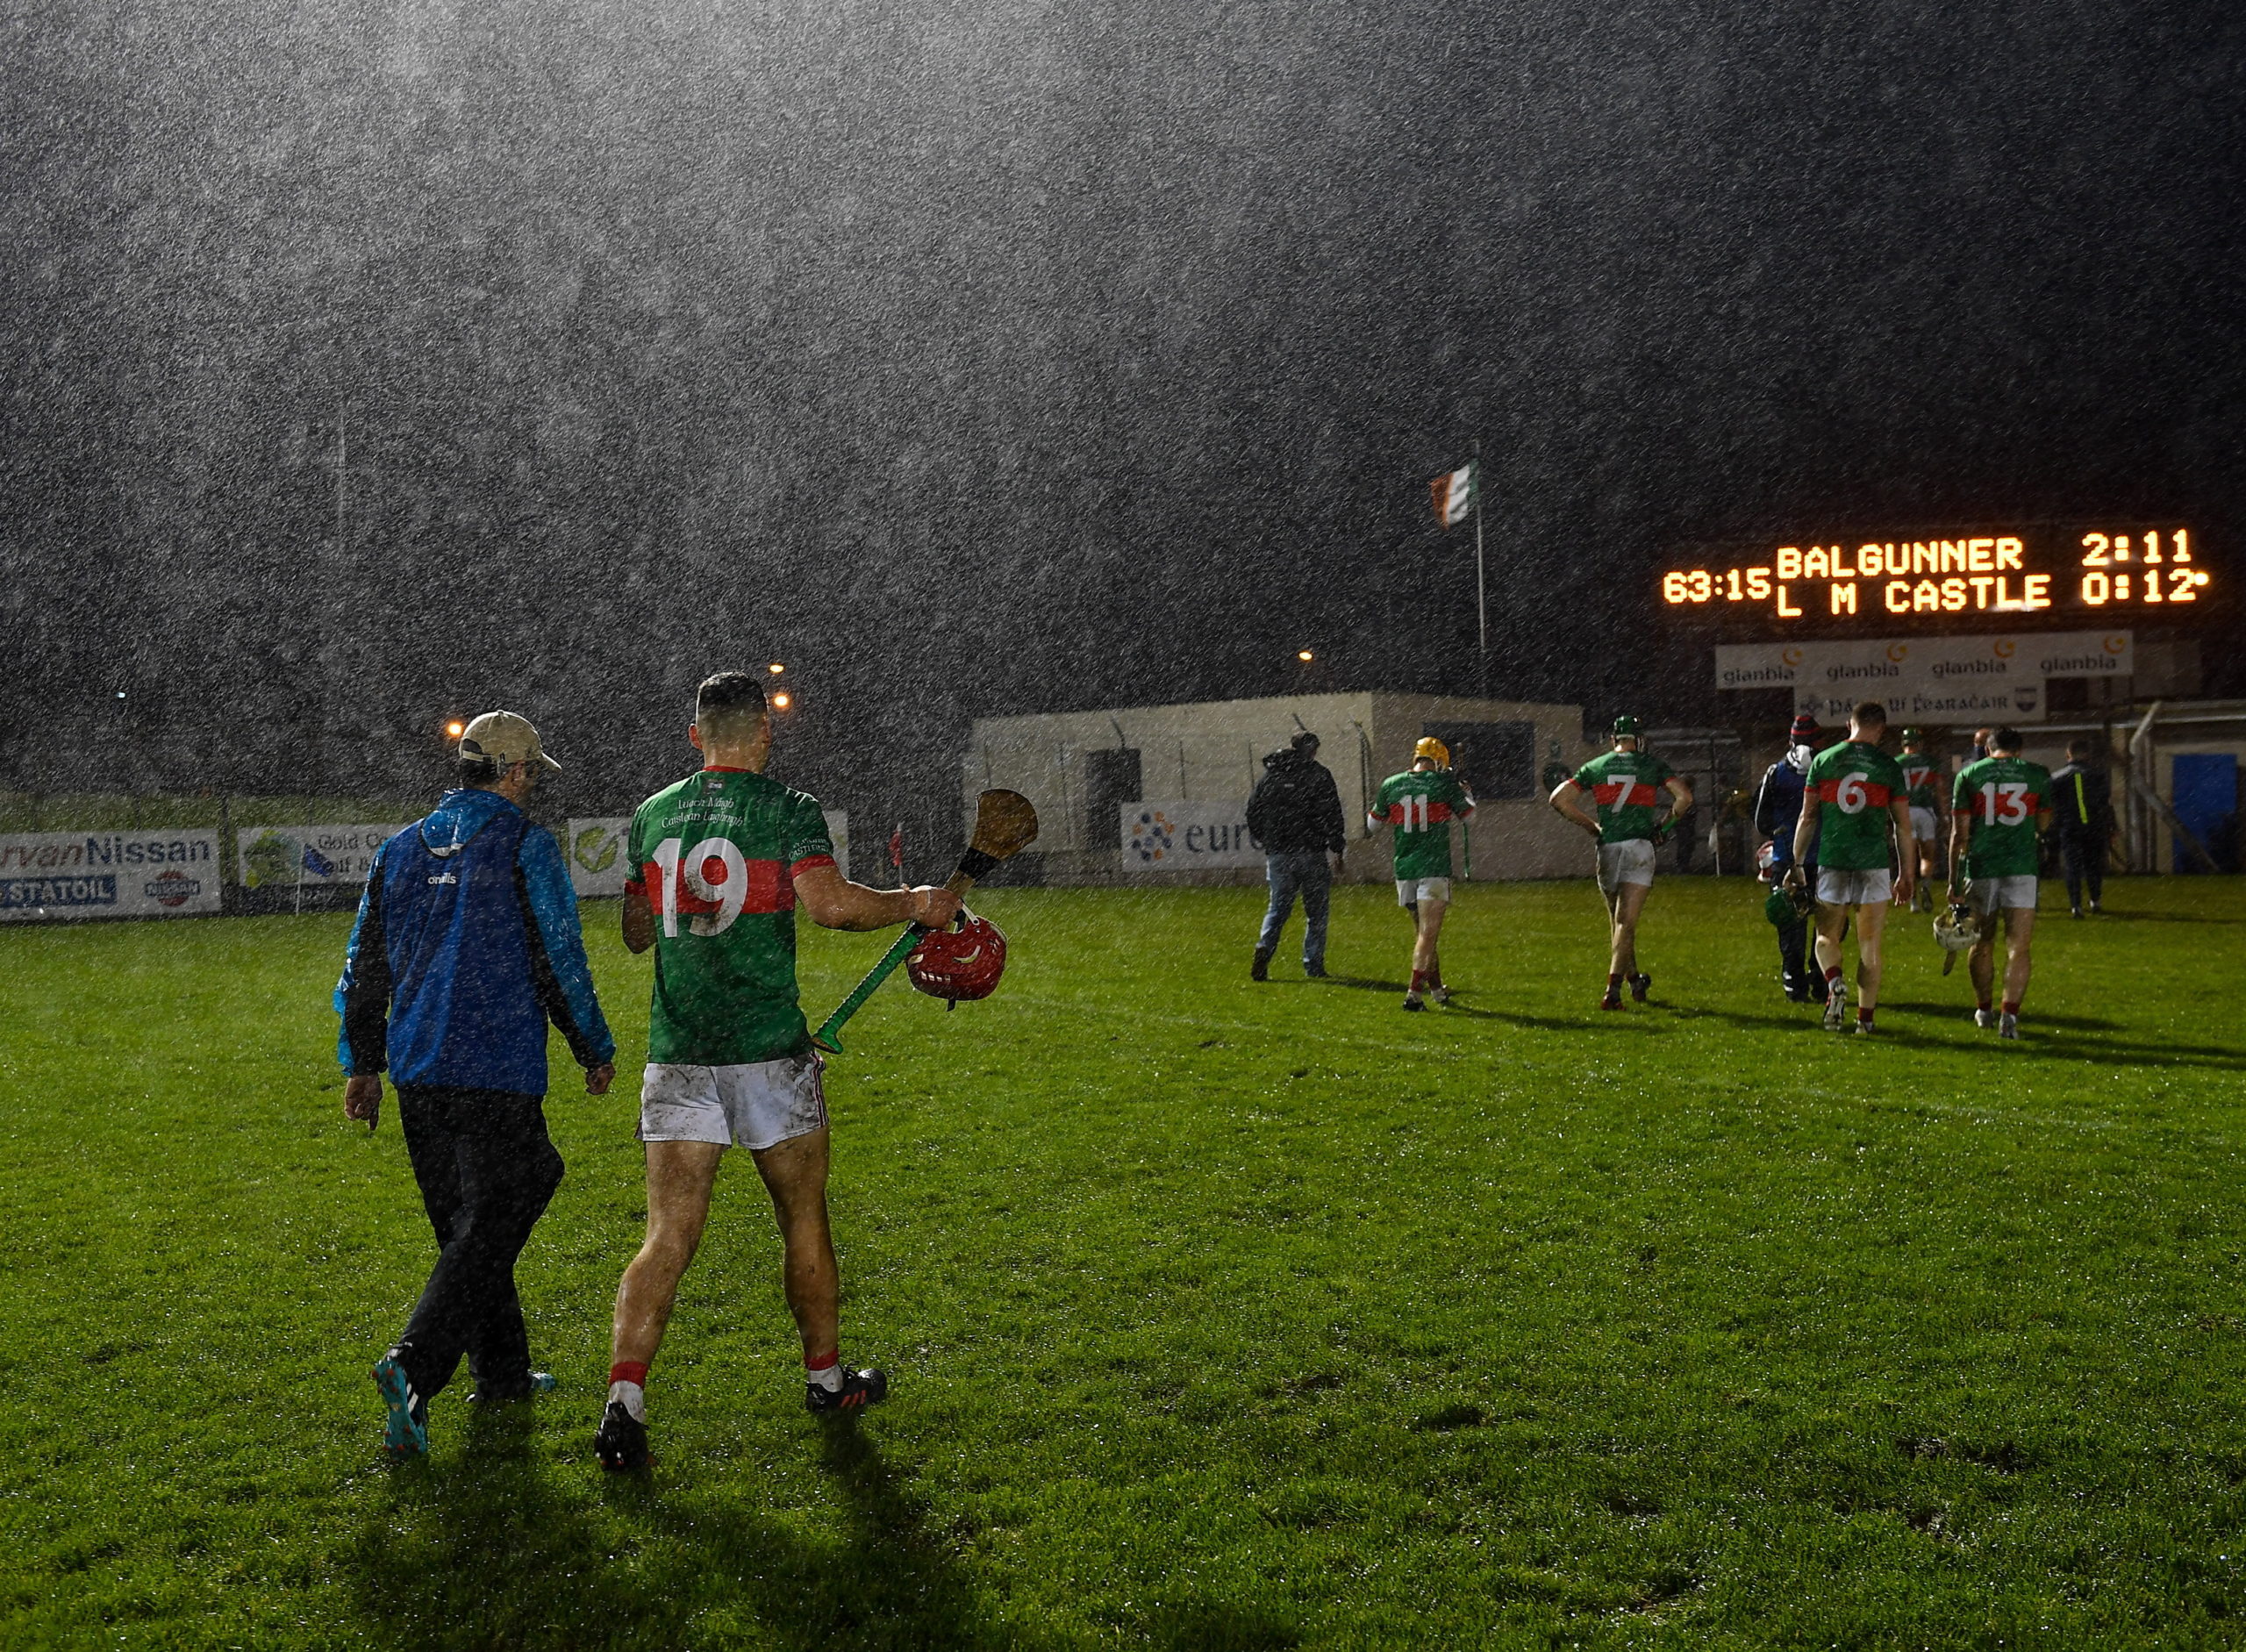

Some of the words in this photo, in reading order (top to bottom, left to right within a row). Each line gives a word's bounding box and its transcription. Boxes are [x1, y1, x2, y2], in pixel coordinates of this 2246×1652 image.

[1777, 537, 2023, 580] BALGUNNER
[2081, 528, 2192, 567] 2:11
[1663, 569, 1771, 604] 63:15
[1777, 584, 1803, 617] L
[1830, 582, 1856, 615] M
[1885, 574, 2051, 613] CASTLE
[2081, 568, 2197, 605] 0:12
[1723, 665, 1795, 683] glanbia
[1826, 662, 1900, 682] glanbia
[1931, 659, 2007, 677] glanbia
[2040, 654, 2117, 674] glanbia
[1607, 774, 1636, 813] 7
[1837, 771, 1869, 814] 6
[1902, 766, 1930, 791] 17
[1399, 793, 1428, 833] 11
[1980, 782, 2028, 826] 13
[87, 835, 210, 865] Nissan
[10, 877, 111, 903] STATOIL
[652, 837, 748, 938] 19
